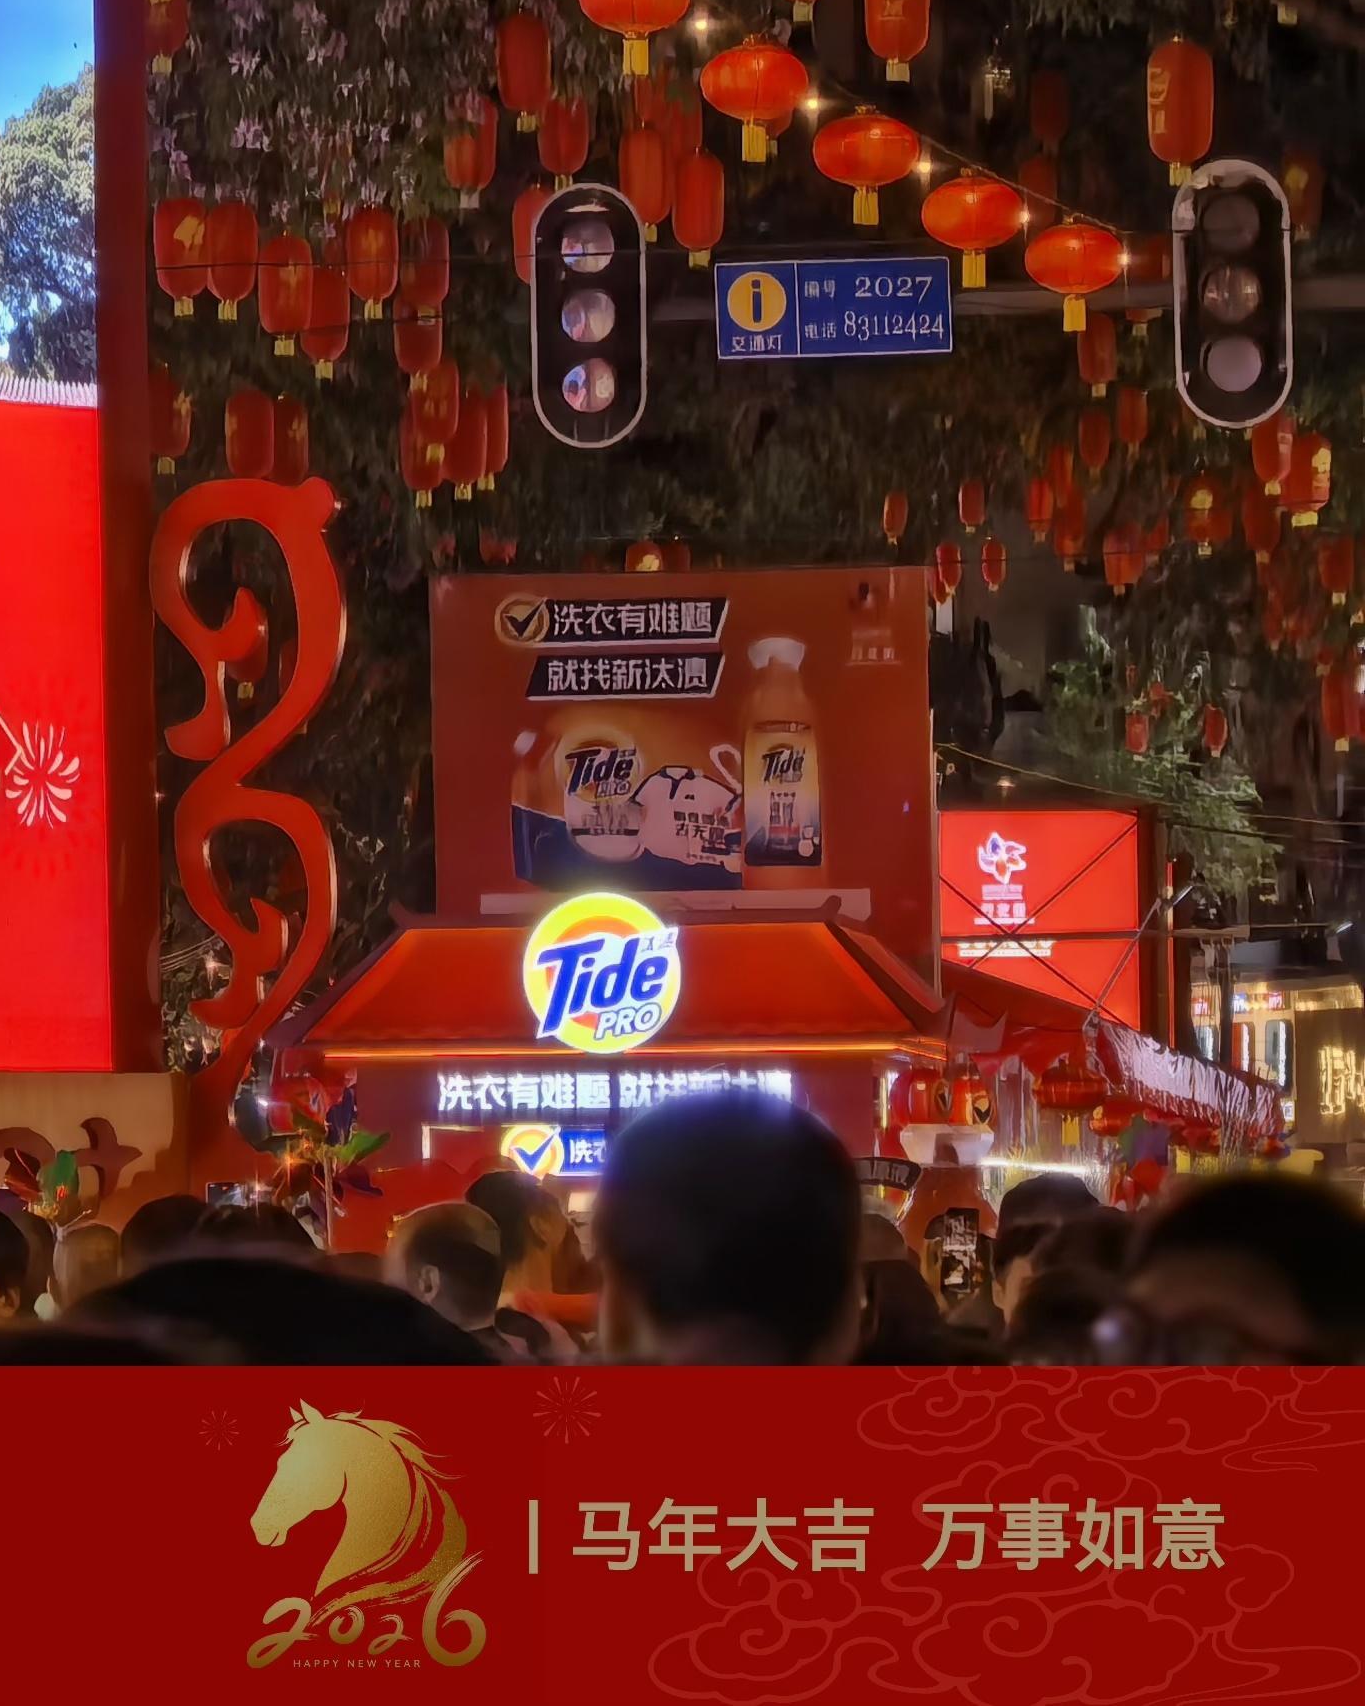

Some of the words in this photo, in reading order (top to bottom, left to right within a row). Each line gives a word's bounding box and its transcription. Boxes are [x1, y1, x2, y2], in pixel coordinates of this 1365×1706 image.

[854, 276, 933, 305] 2027
[731, 334, 783, 352] 交通灯
[843, 310, 944, 342] 83112424
[553, 600, 712, 636] 洗衣有难题
[564, 747, 635, 796] Tide
[536, 937, 669, 1034] Tide
[594, 1002, 662, 1041] PRO
[436, 1073, 611, 1112] 洗衣有难题
